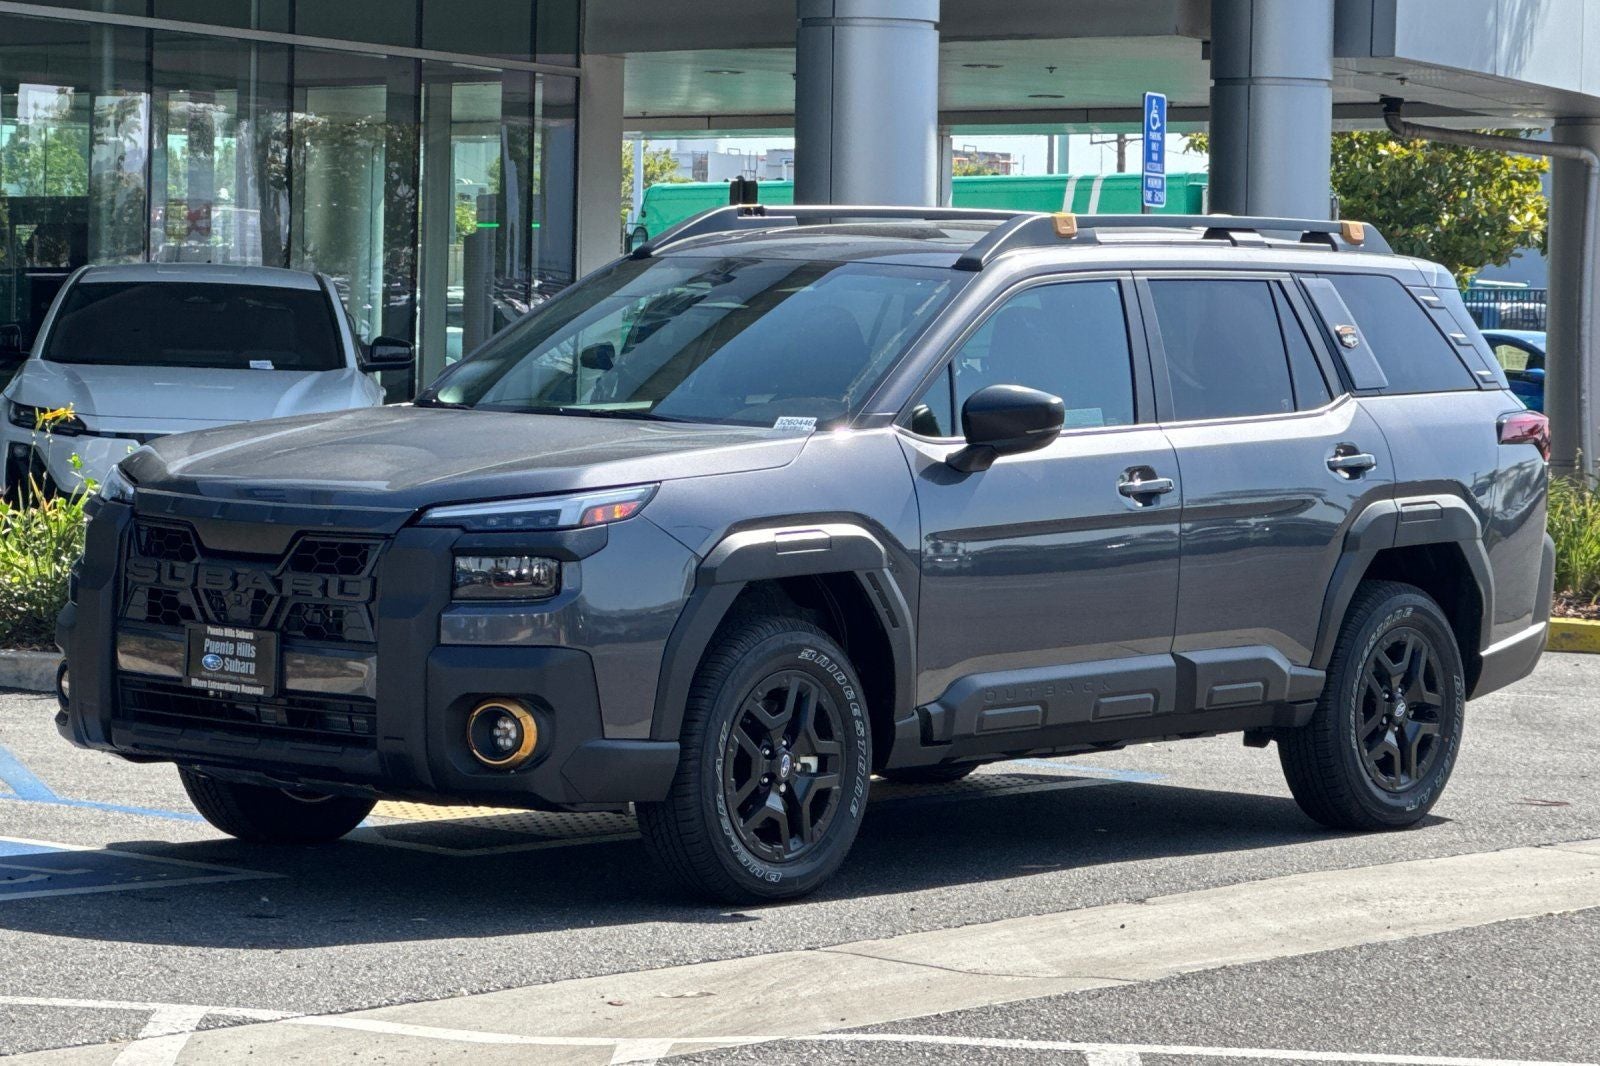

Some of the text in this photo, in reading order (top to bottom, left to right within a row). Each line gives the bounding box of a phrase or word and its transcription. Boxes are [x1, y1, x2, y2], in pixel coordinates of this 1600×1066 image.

[125, 557, 373, 600] SUBARU
[207, 626, 254, 640] Puente Hills Subaru
[204, 638, 256, 658] Puente Hills
[224, 657, 256, 674] Subaru
[191, 677, 208, 688] Where
[208, 680, 240, 693] Extraordinary
[984, 681, 1112, 704] OUTBACK
[798, 648, 866, 818] BRIDGESTONE
[716, 791, 782, 882] DUELER
